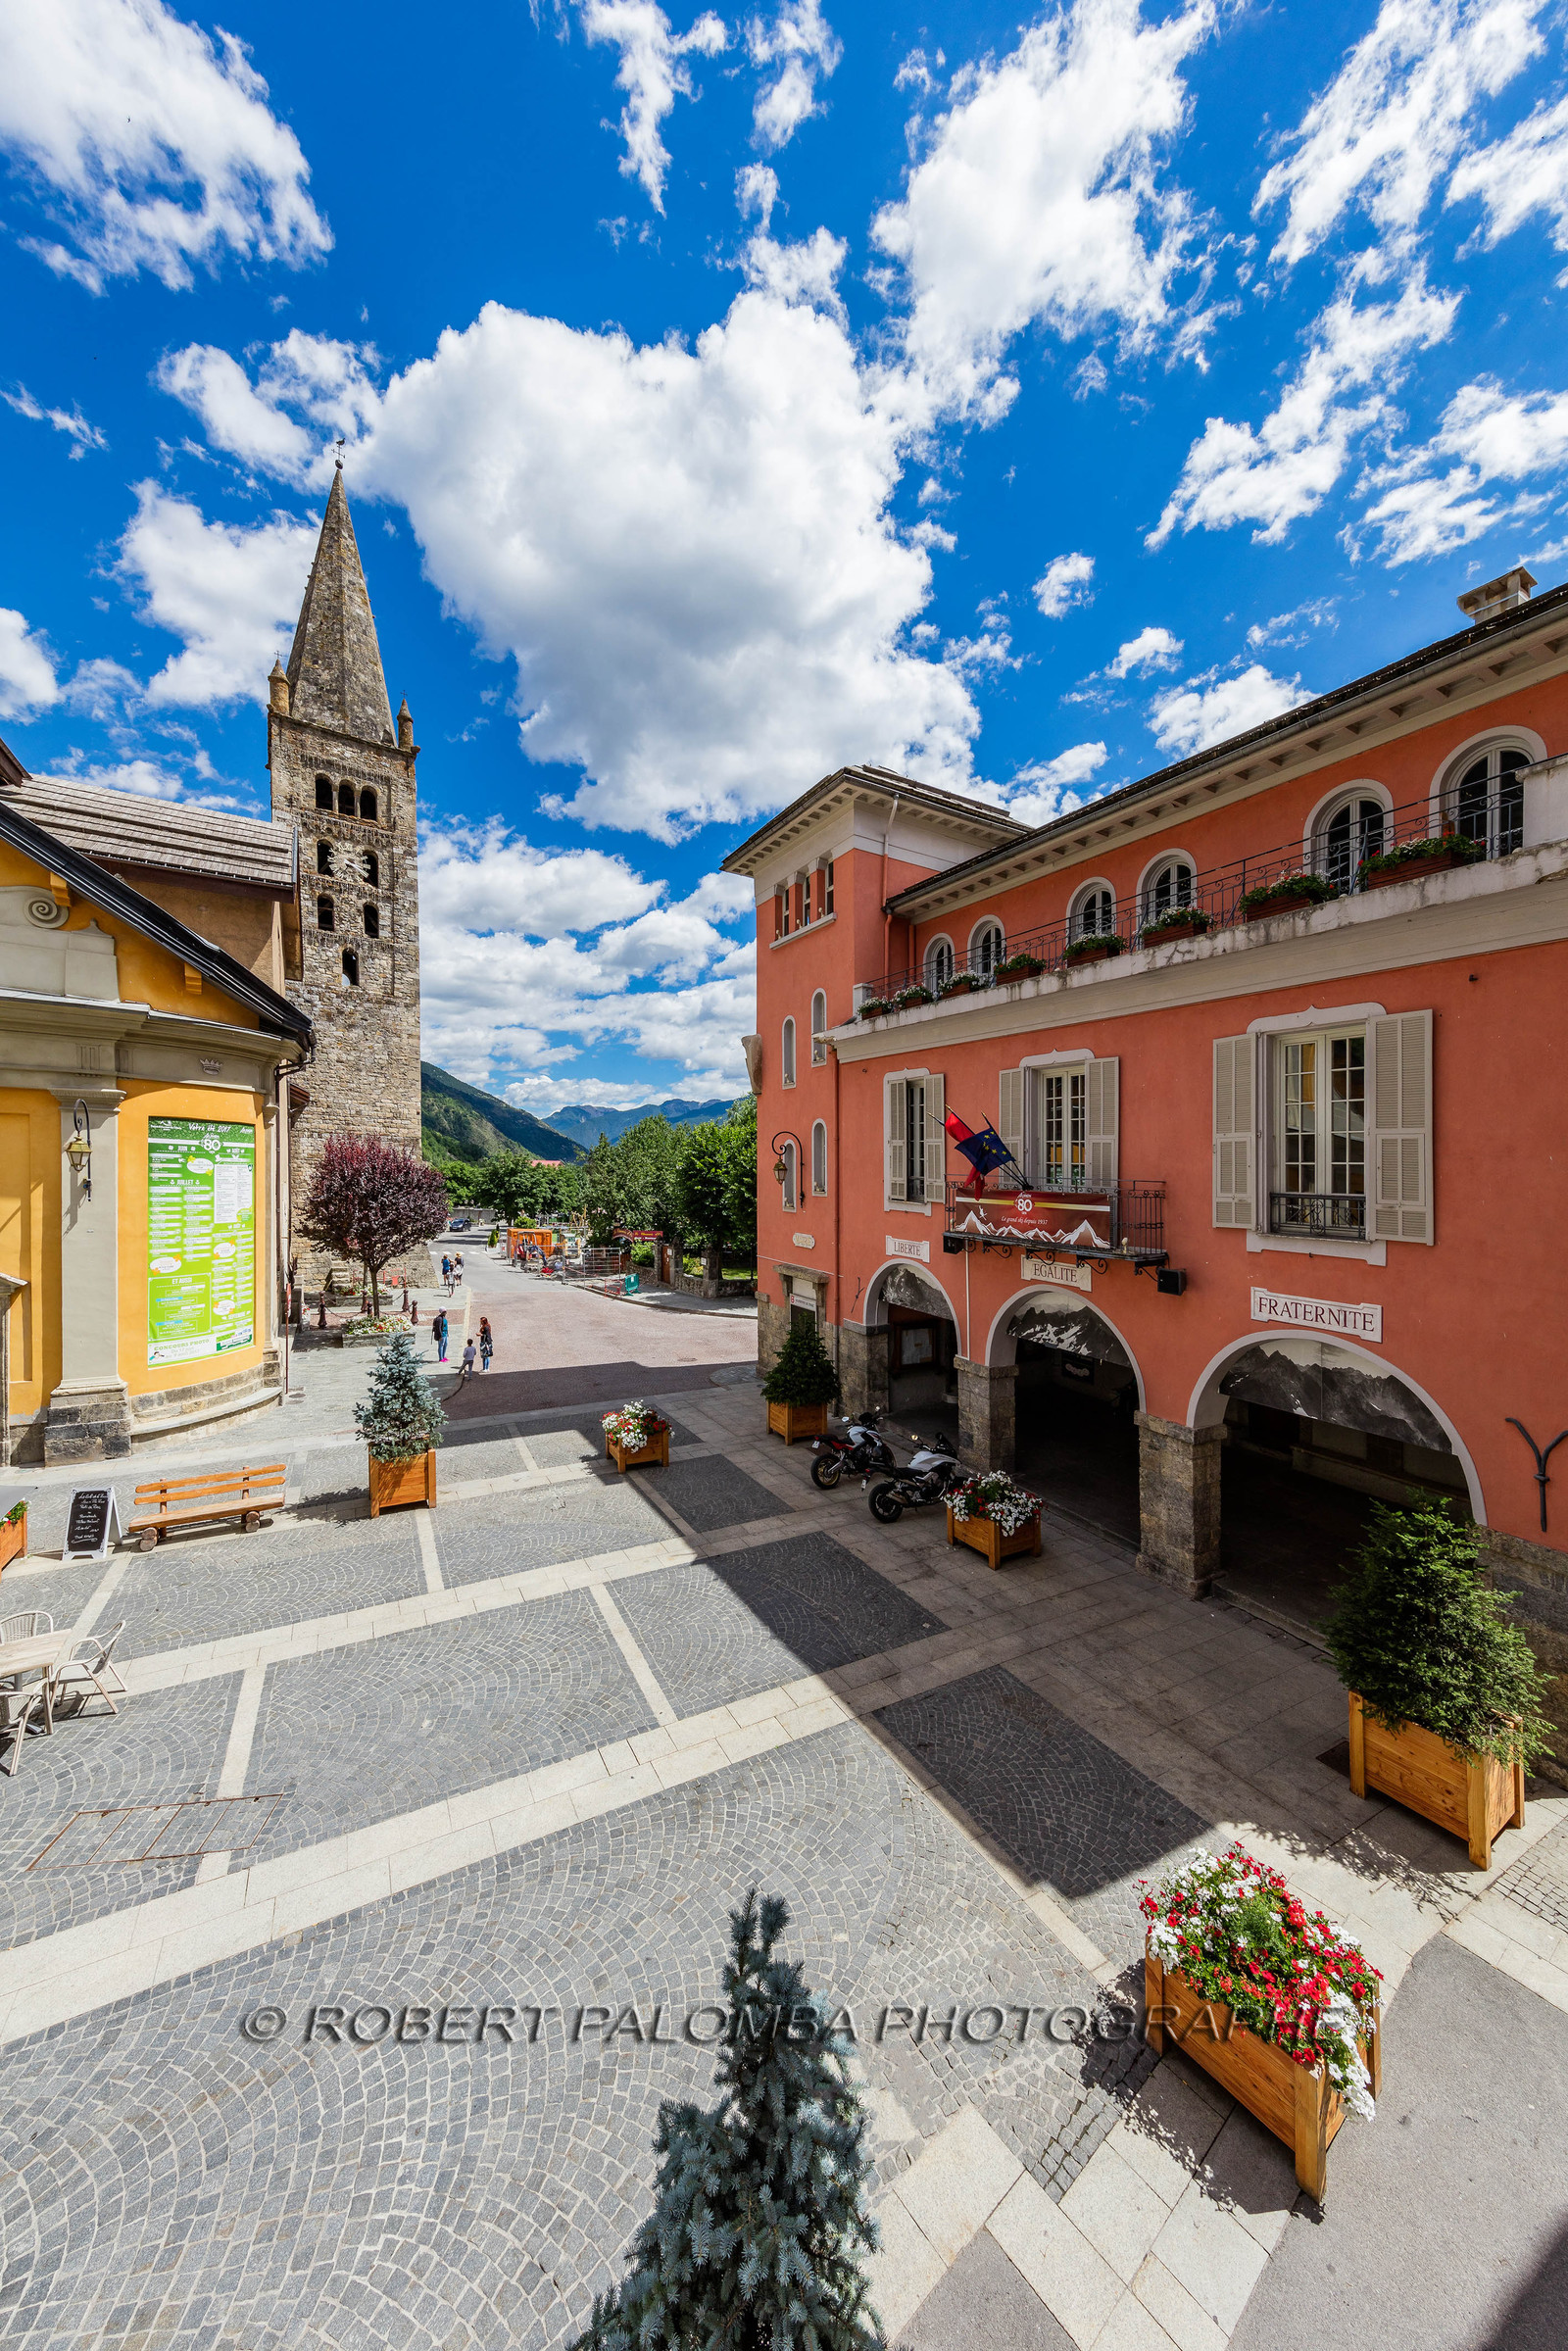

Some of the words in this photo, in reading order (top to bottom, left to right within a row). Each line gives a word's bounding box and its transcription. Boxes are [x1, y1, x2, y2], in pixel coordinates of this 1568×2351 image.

[204, 1139, 221, 1151] 80
[1017, 1199, 1033, 1212] 80
[894, 1241, 921, 1256] LIBERTE
[1033, 1263, 1078, 1283] EGALITE
[1258, 1297, 1375, 1332] FRATERNITE
